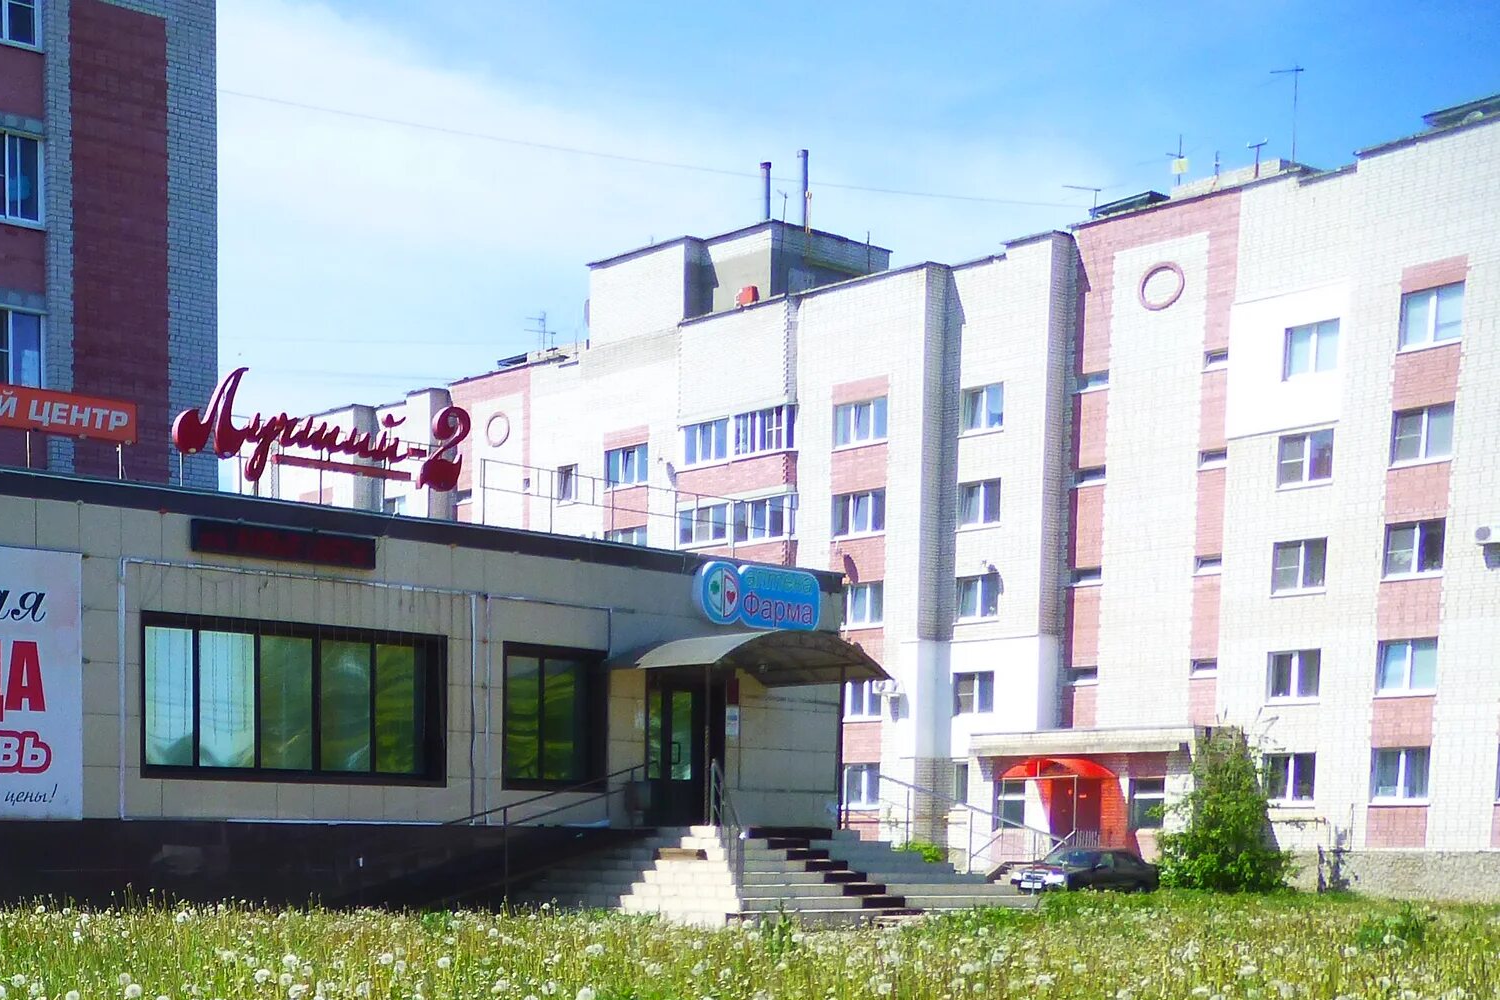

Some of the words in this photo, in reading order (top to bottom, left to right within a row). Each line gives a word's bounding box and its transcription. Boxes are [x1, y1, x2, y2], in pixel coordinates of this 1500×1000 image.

[28, 399, 129, 432] ЦЕНТР
[743, 590, 813, 628] Фарма
[4, 783, 57, 805] цены!
